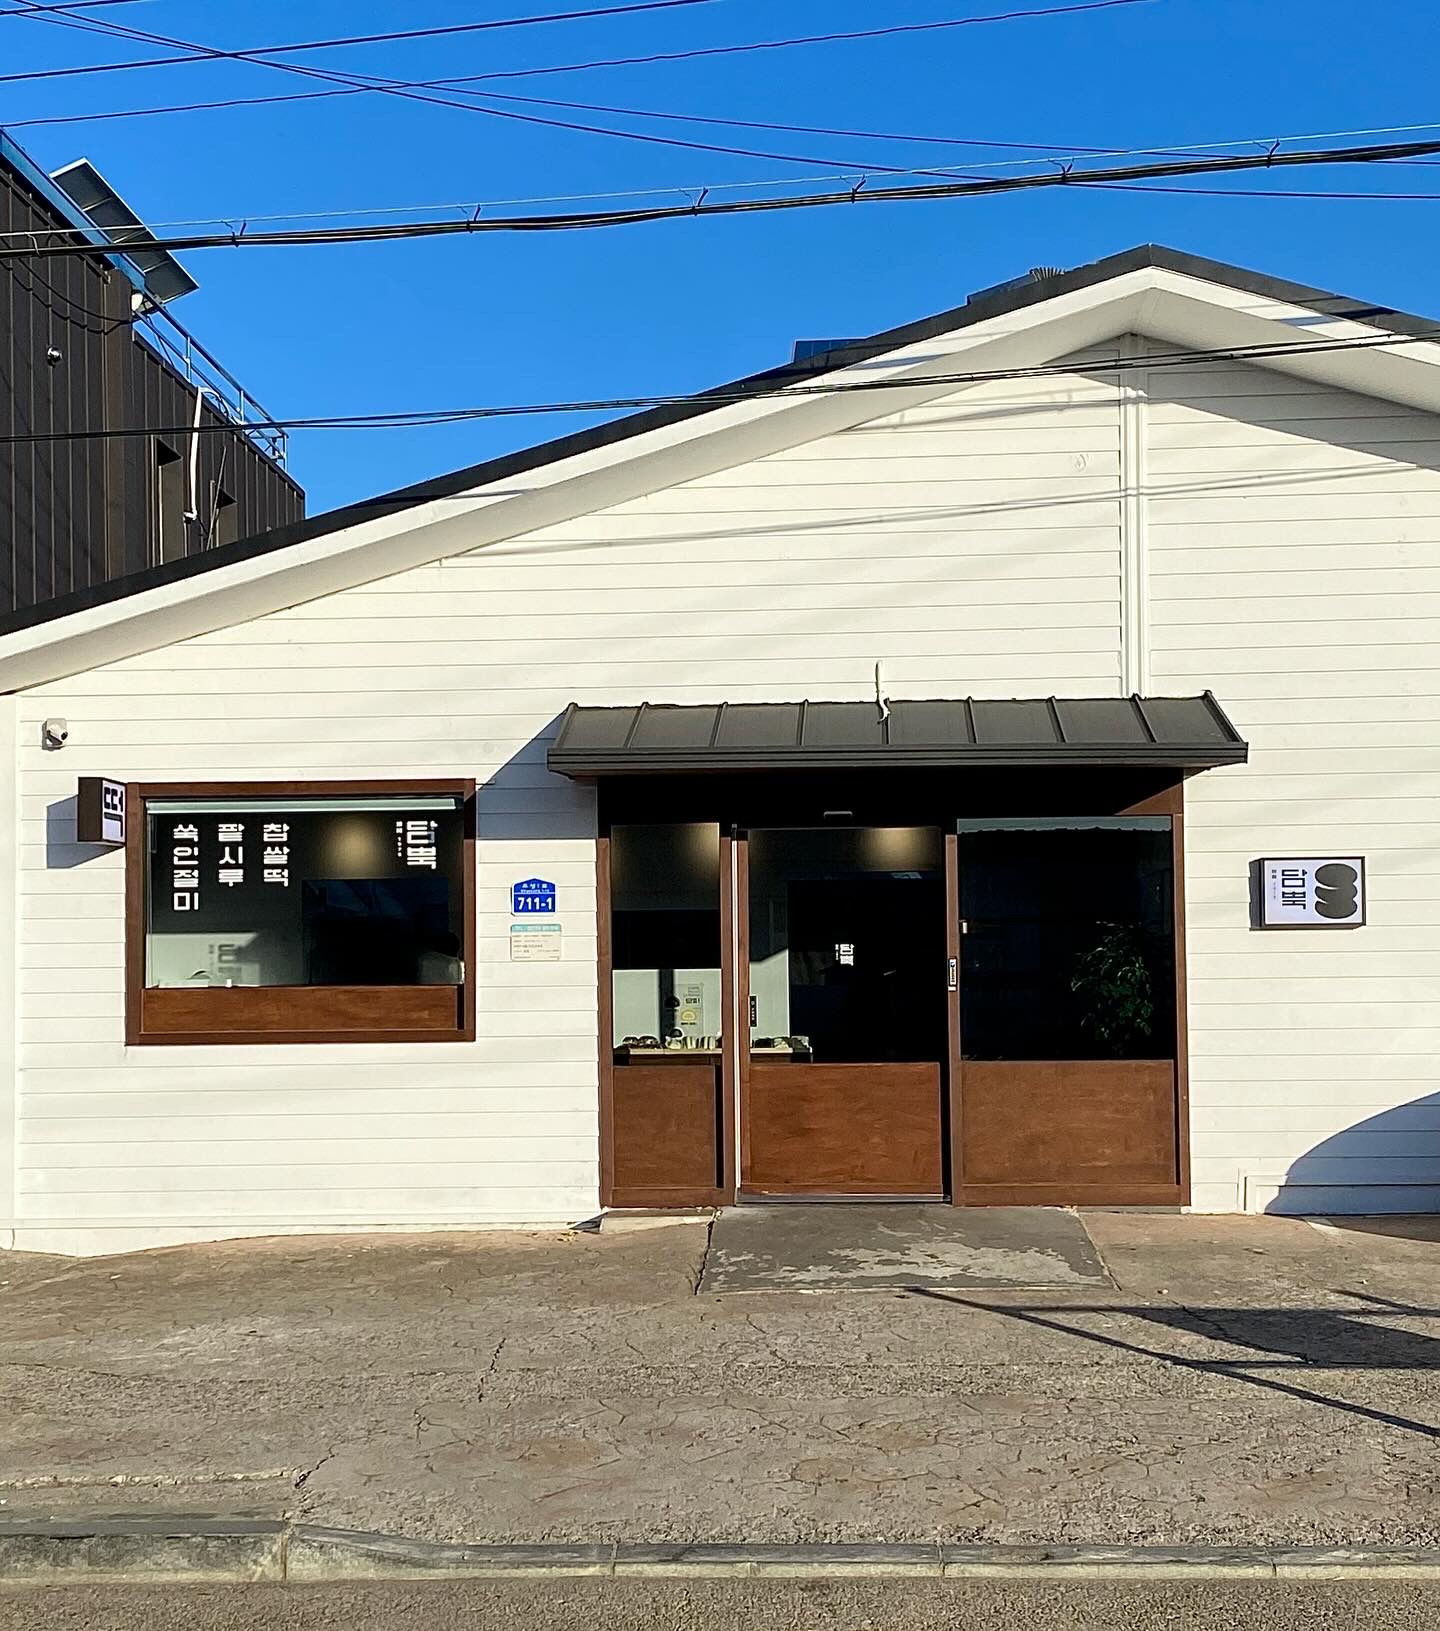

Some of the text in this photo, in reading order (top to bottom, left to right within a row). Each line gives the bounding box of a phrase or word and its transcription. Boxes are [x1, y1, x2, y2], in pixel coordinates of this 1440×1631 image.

[104, 786, 124, 837] 떡
[173, 823, 199, 911] 쑥인절미
[218, 823, 245, 887] 팥시루
[263, 823, 290, 887] 찹쌀떡
[406, 820, 438, 870] 담뿍
[518, 897, 552, 910] 711-1
[1281, 868, 1308, 910] 담뿍
